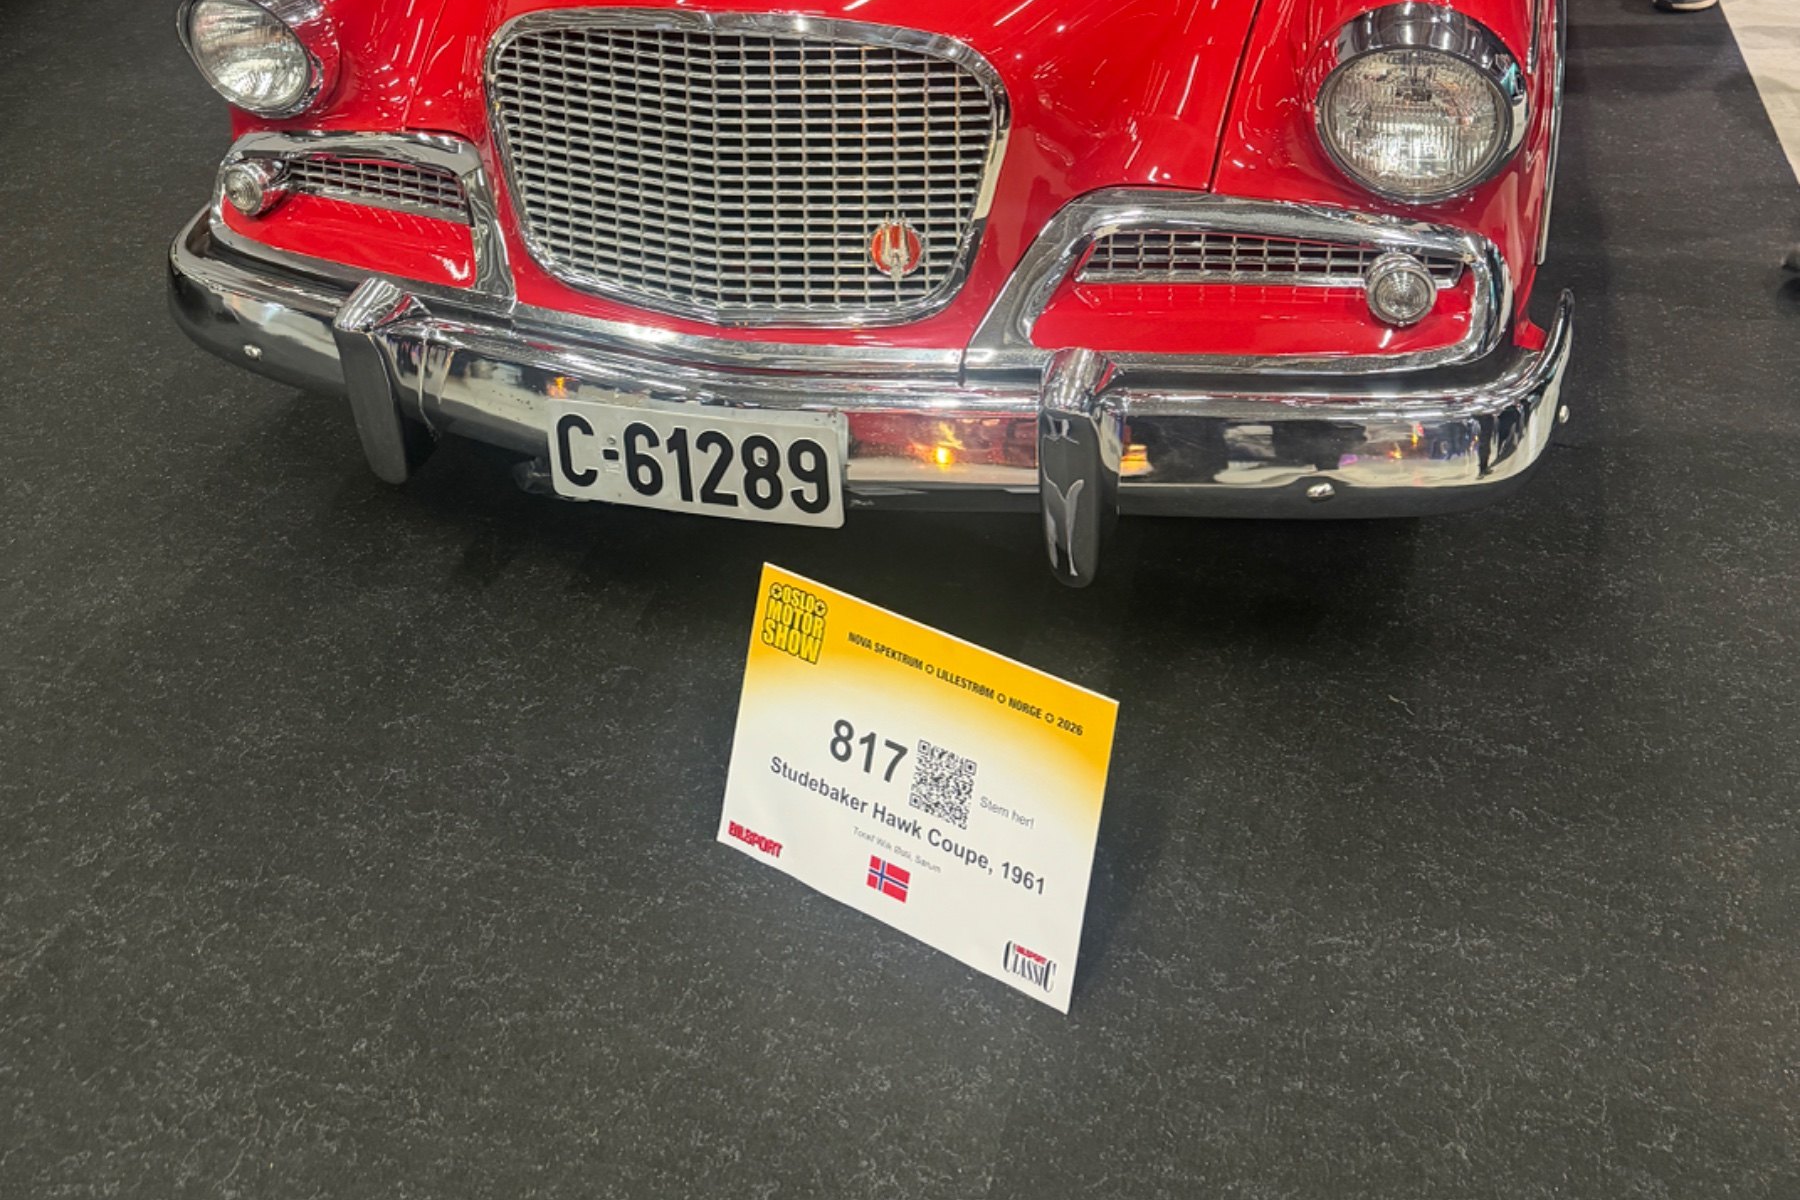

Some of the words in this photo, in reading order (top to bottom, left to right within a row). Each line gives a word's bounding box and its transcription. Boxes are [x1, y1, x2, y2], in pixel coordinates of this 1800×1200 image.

[556, 413, 832, 515] C-61289
[766, 598, 825, 642] MOTOR
[782, 584, 815, 614] OSLO
[761, 617, 822, 665] SHOW
[848, 631, 872, 650] NOVA
[874, 642, 924, 671] SPEKTRUM
[936, 667, 995, 700] LILLESTRØM
[1008, 697, 1042, 720] NORGE
[1057, 716, 1084, 736] 2026
[830, 719, 909, 783] 817
[770, 756, 868, 813] Studebaker
[872, 802, 922, 840] Hawk
[927, 828, 993, 875] Coupe,
[1001, 861, 1046, 895] 1961
[979, 795, 1010, 818] Stem
[1011, 809, 1035, 830] her!
[728, 820, 783, 858] BILSPORT
